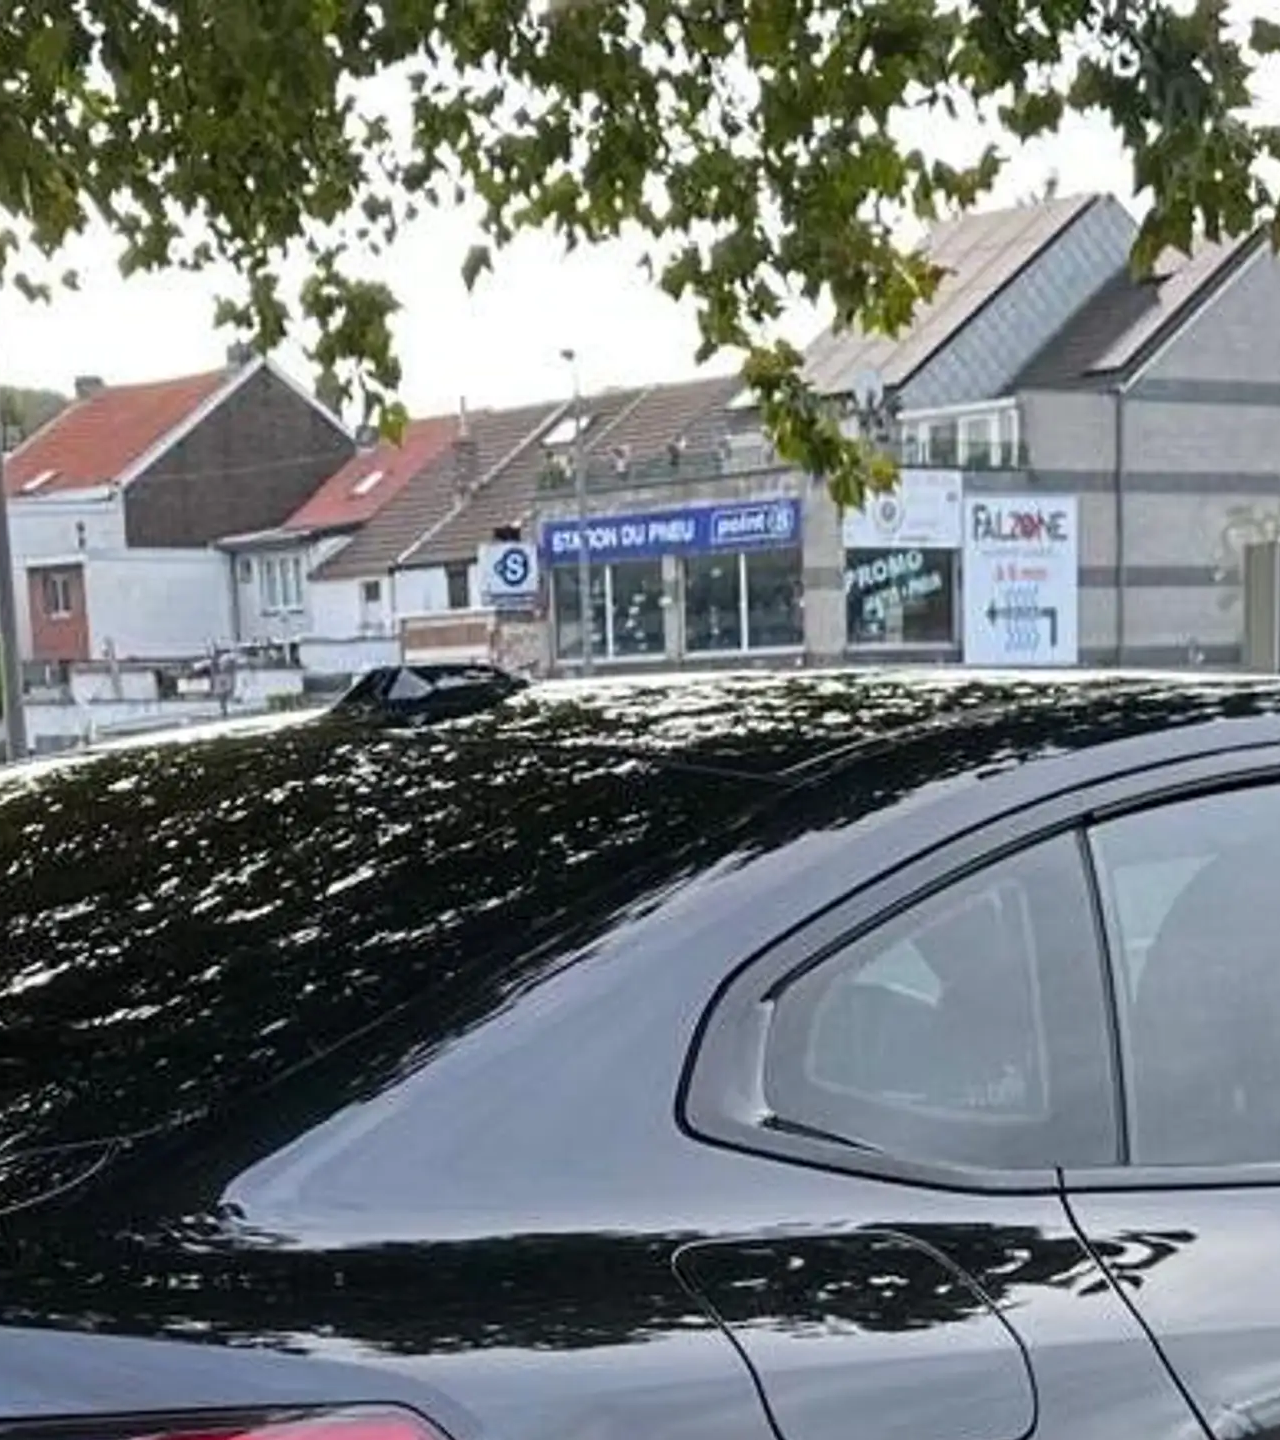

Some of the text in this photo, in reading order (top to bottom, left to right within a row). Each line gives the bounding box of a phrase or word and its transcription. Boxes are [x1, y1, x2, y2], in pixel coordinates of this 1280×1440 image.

[621, 523, 645, 546] DU
[648, 518, 696, 543] PNEU
[972, 503, 1068, 543] FALZONE
[843, 549, 923, 595] PROMO
